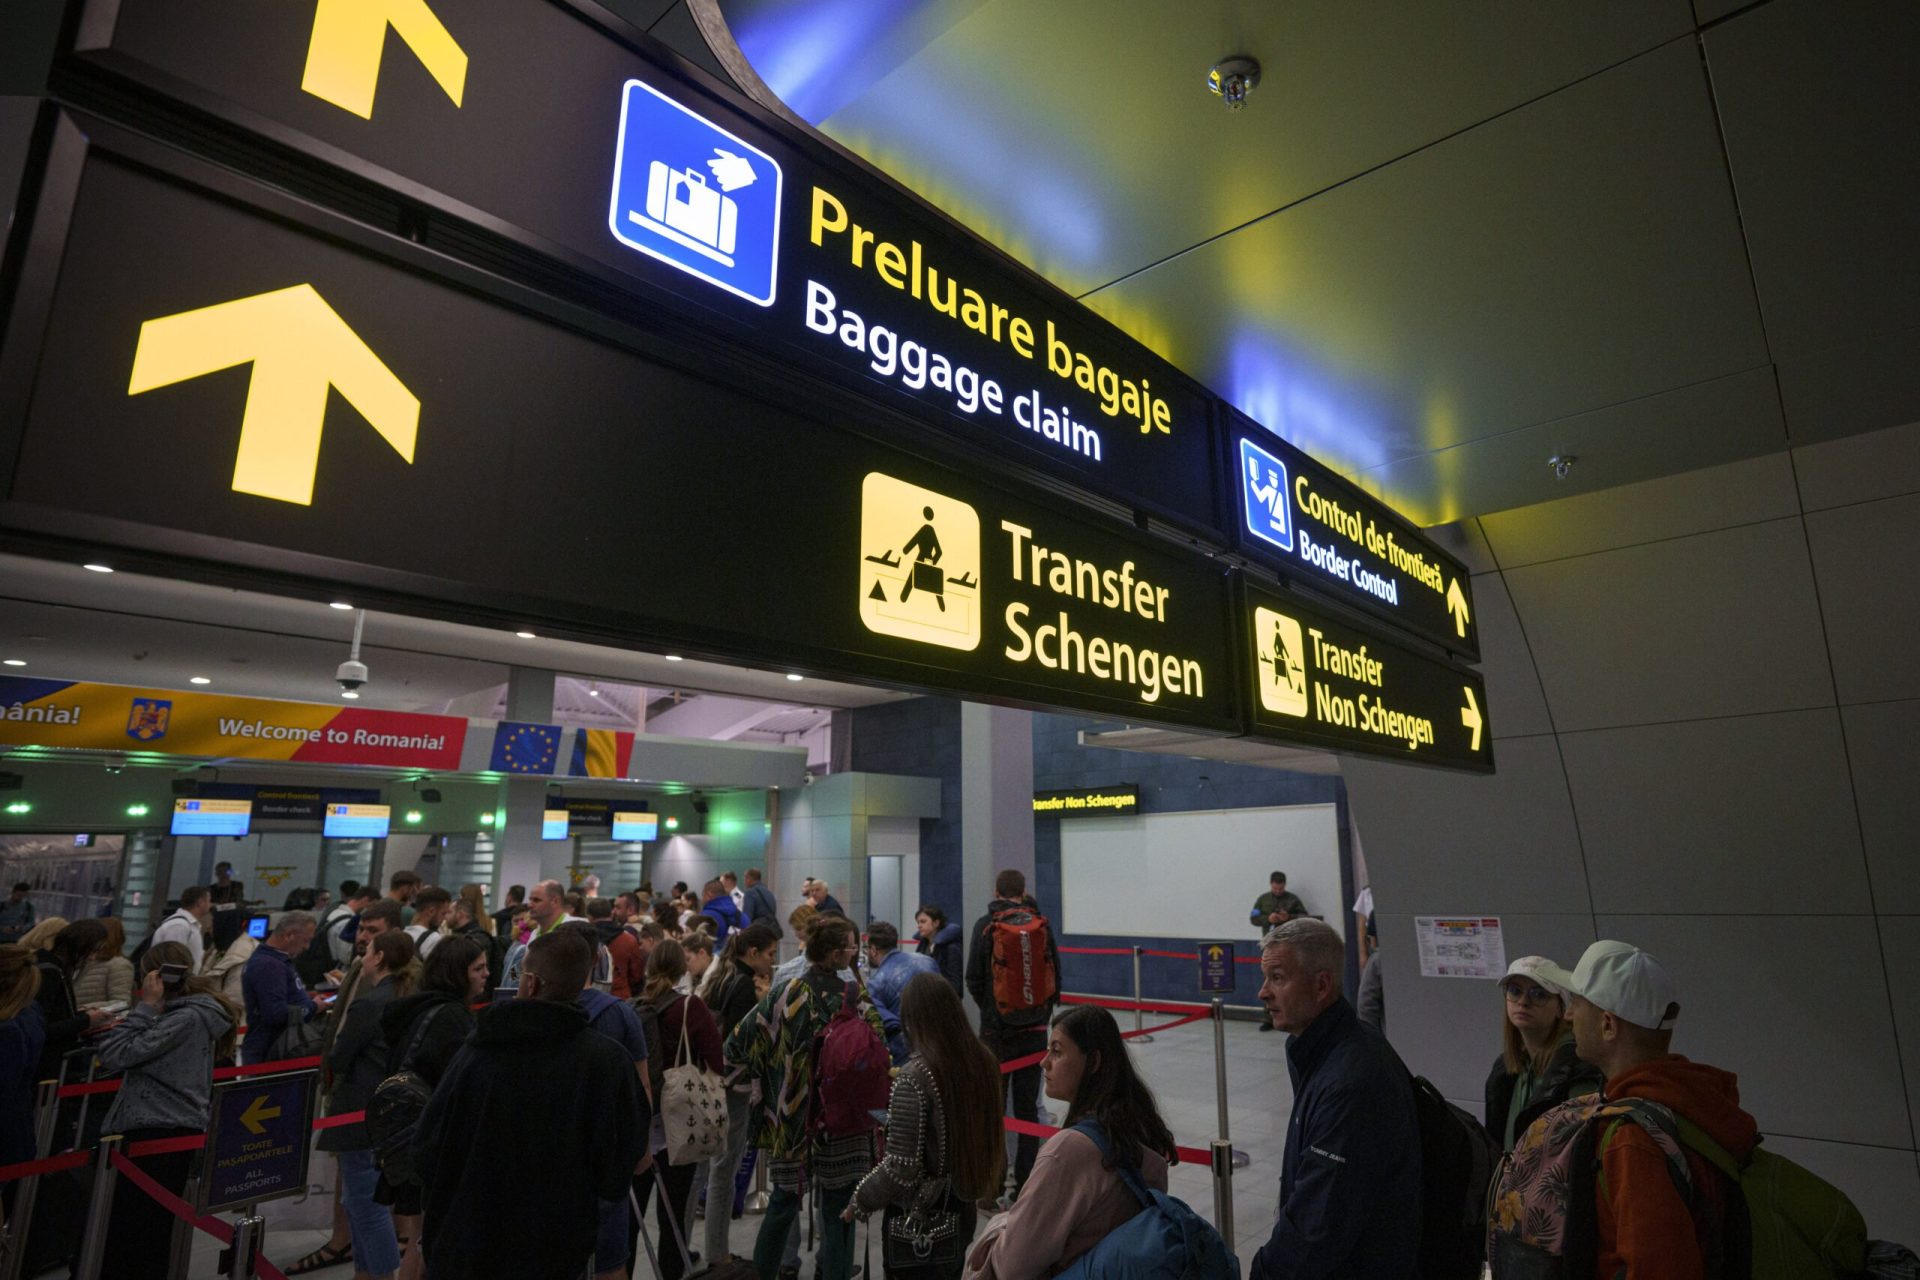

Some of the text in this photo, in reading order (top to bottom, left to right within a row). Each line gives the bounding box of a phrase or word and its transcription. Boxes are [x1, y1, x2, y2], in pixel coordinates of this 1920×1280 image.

[810, 186, 1171, 434] Preluare bagaje
[805, 279, 1101, 461] Baggage claim
[1295, 476, 1444, 594] Control de frontieră
[1001, 519, 1170, 623] Transfer
[1299, 529, 1398, 606] Border Control
[1005, 601, 1204, 703] Schengen
[1308, 628, 1383, 687] Transfer
[0, 701, 81, 724] ânia!
[218, 717, 446, 750] Welcome to Romania!
[1314, 681, 1434, 750] Non Schengen
[1032, 794, 1136, 811] ransfer Non Schengen
[241, 1139, 273, 1153] TOATE
[245, 1168, 264, 1181] ALL
[224, 1174, 282, 1195] PASSPORTS
